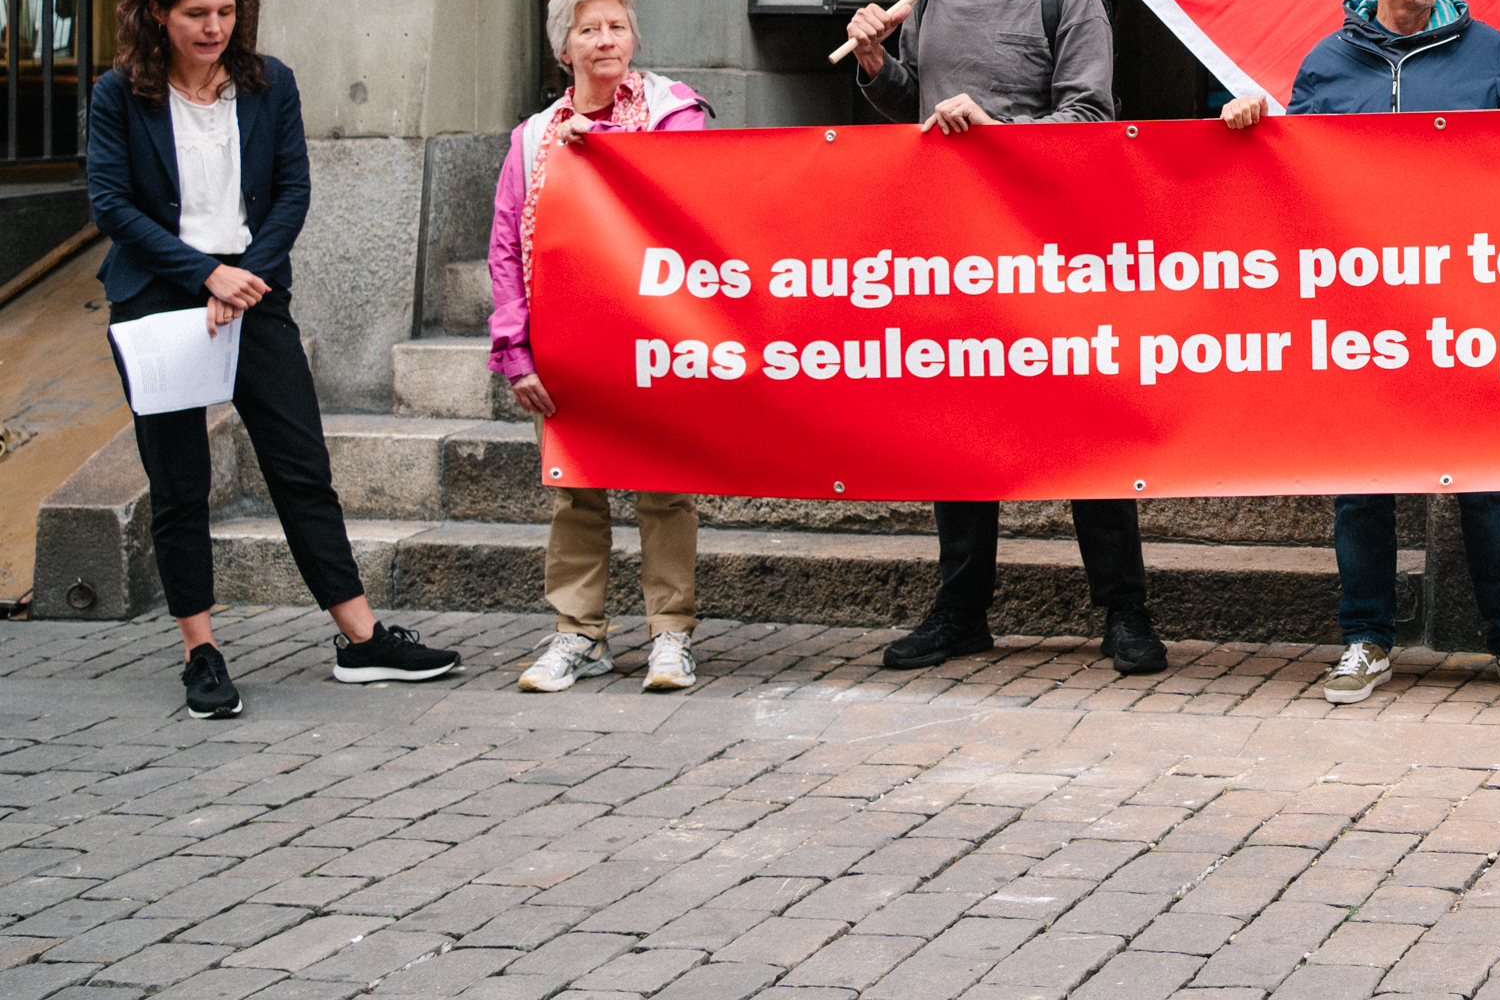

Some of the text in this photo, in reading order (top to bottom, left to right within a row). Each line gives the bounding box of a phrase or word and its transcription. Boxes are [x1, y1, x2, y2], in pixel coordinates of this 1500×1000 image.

[638, 247, 751, 298] Des
[769, 239, 1279, 308] augmentations
[1300, 244, 1450, 299] pour
[635, 338, 747, 388] pas
[762, 323, 1119, 380] seulement
[1140, 331, 1291, 385] pour
[1310, 319, 1410, 371] les
